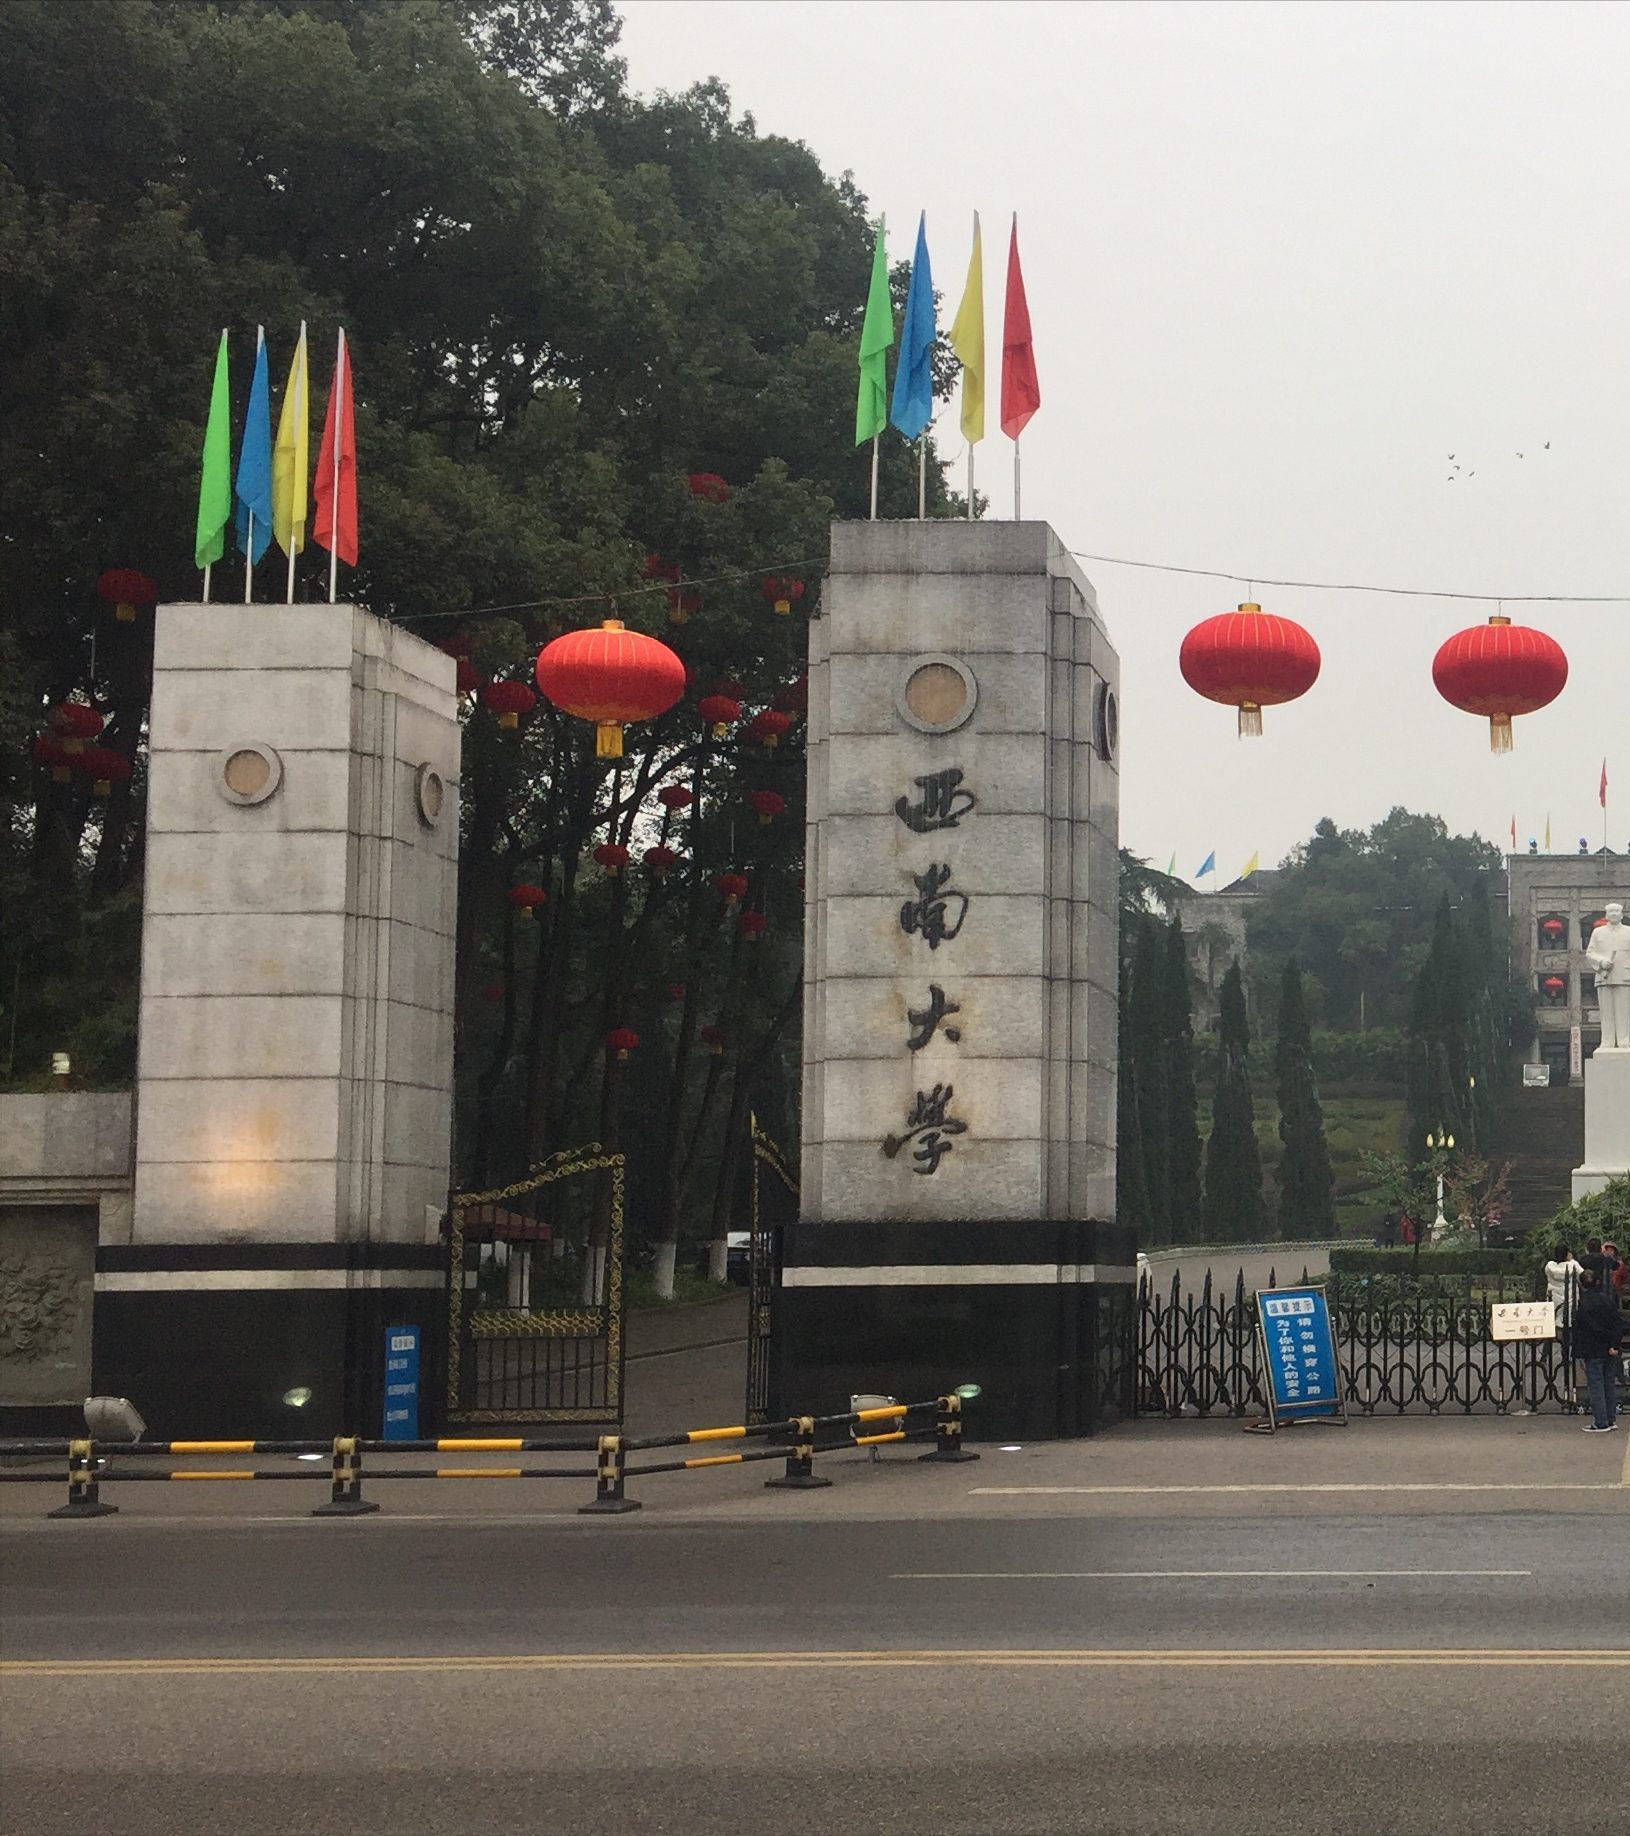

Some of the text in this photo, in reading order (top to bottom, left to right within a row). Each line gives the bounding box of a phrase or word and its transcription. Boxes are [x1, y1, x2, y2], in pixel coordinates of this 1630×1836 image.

[1276, 1319, 1301, 1397] 为了你和他人的安全
[1297, 1317, 1321, 1395] 请勿横穿公路
[1505, 1325, 1544, 1336] 一号门
